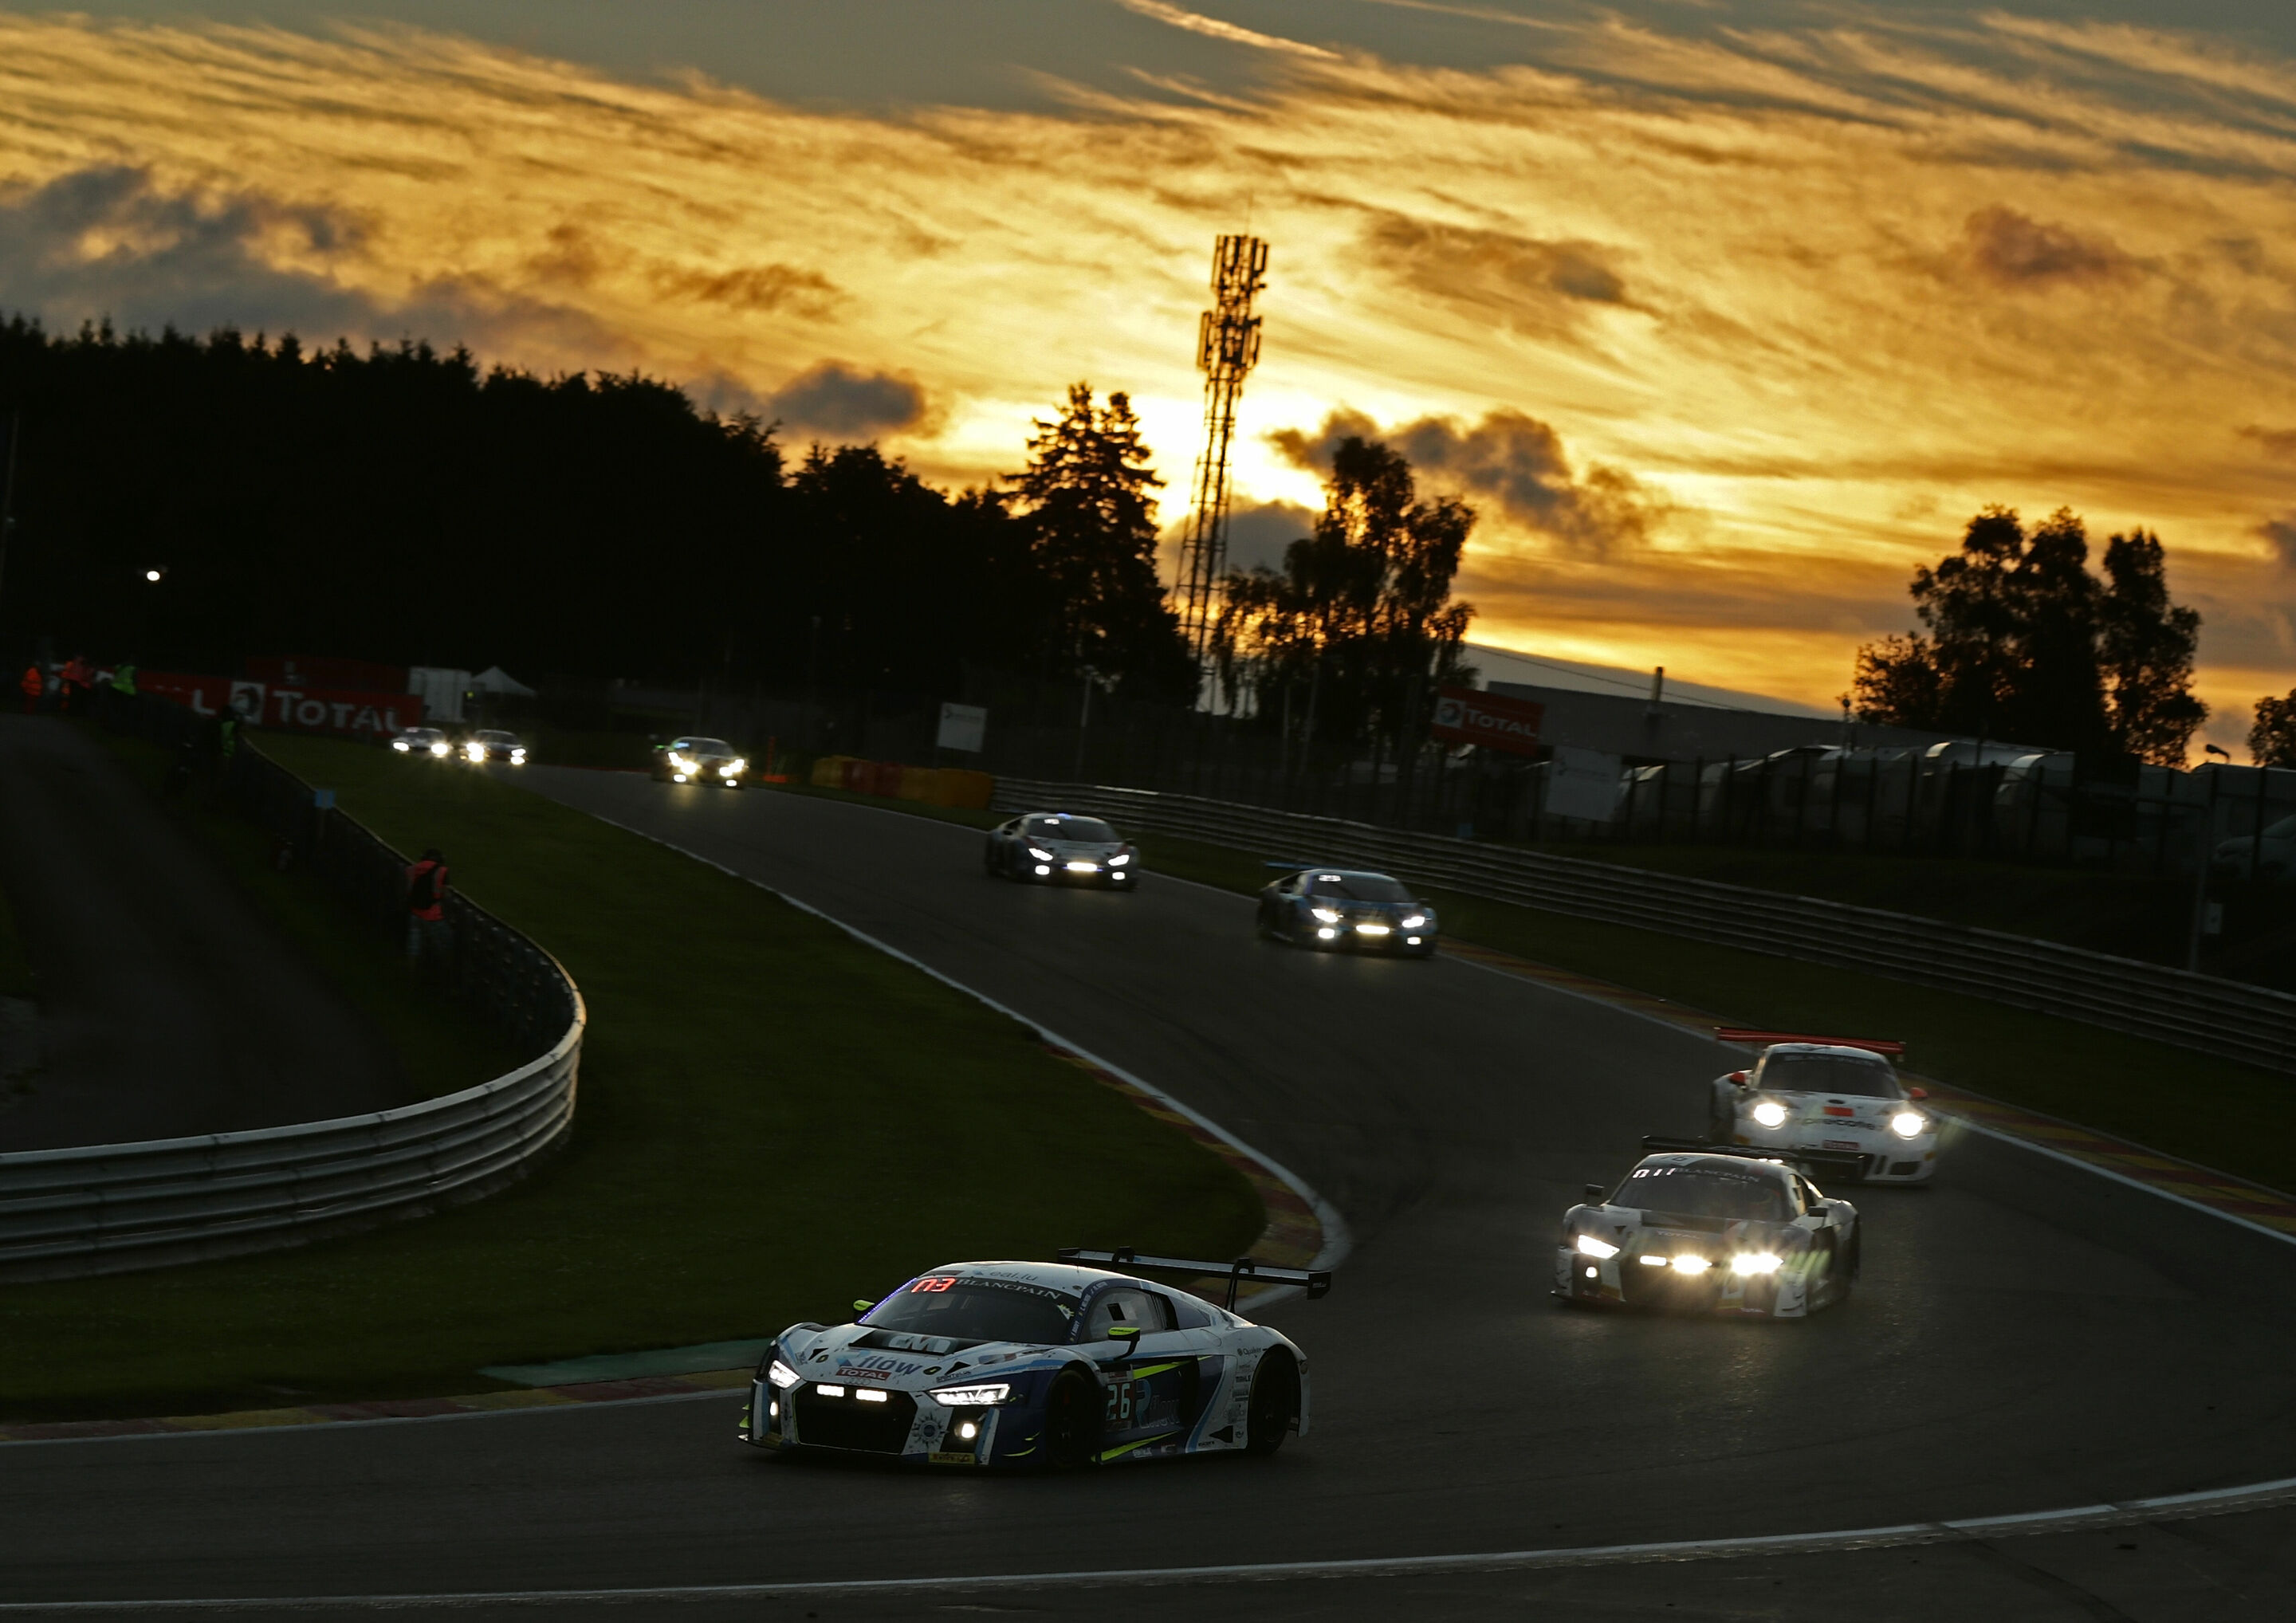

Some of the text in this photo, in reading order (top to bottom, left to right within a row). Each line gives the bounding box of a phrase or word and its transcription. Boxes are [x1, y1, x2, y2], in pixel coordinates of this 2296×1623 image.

[273, 689, 402, 733] TOTAL
[1466, 707, 1537, 737] TOTAL
[957, 1278, 1063, 1299] BLANCPAIN
[840, 1367, 890, 1380] TOTAL
[858, 1355, 923, 1375] flow
[1106, 1382, 1131, 1421] 26
